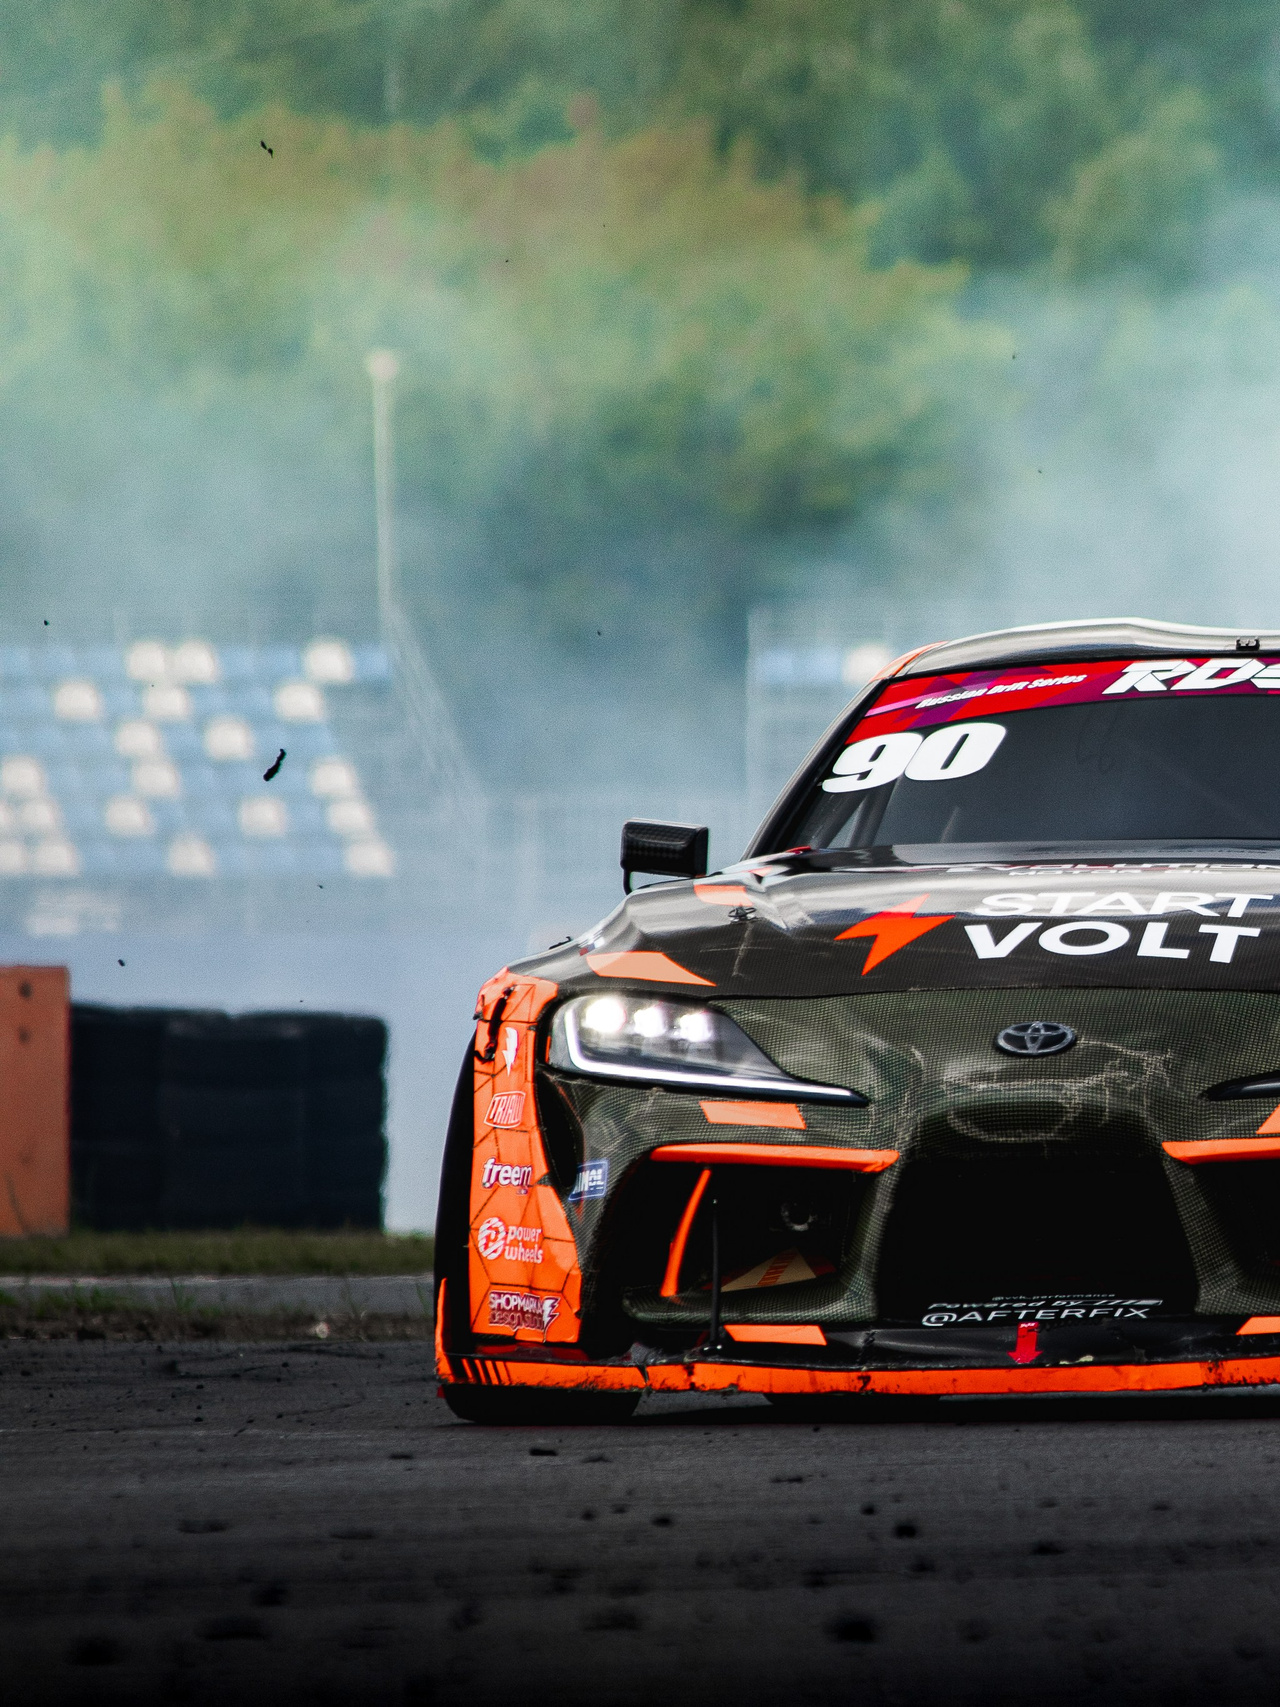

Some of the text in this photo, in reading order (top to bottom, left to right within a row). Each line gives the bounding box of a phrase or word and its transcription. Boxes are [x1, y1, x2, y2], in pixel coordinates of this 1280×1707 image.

[915, 674, 1088, 710] Russian Drift Series
[822, 721, 1006, 794] 90
[973, 891, 1274, 919] START
[964, 920, 1261, 964] VOLT
[482, 1158, 532, 1188] freem
[506, 1225, 542, 1244] power
[504, 1242, 543, 1264] wheels
[922, 1307, 1151, 1327] @AFTERFIX
[928, 1300, 1083, 1310] Powered by
